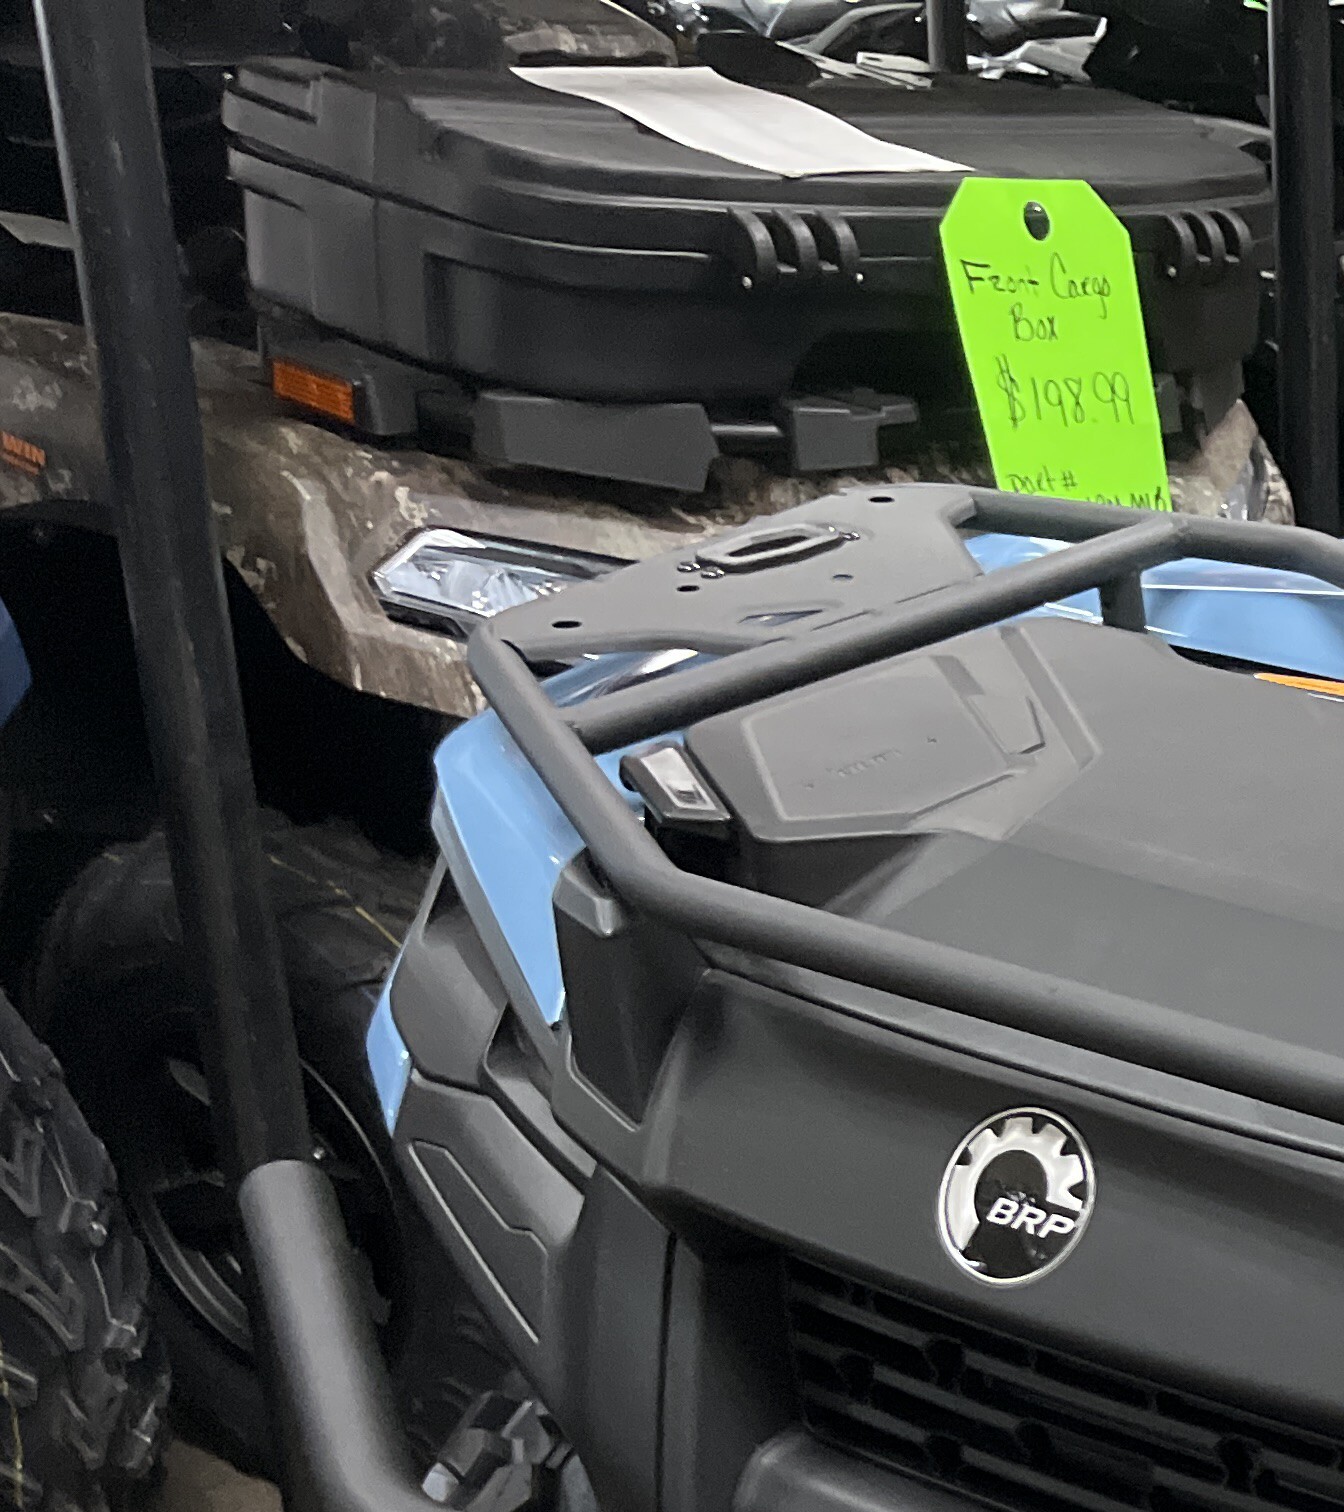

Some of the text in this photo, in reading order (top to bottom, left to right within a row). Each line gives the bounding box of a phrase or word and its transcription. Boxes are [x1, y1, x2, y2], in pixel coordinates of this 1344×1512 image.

[1009, 301, 1059, 341] Box
[995, 353, 1135, 430] $198.99
[986, 1197, 1076, 1239] BRP
